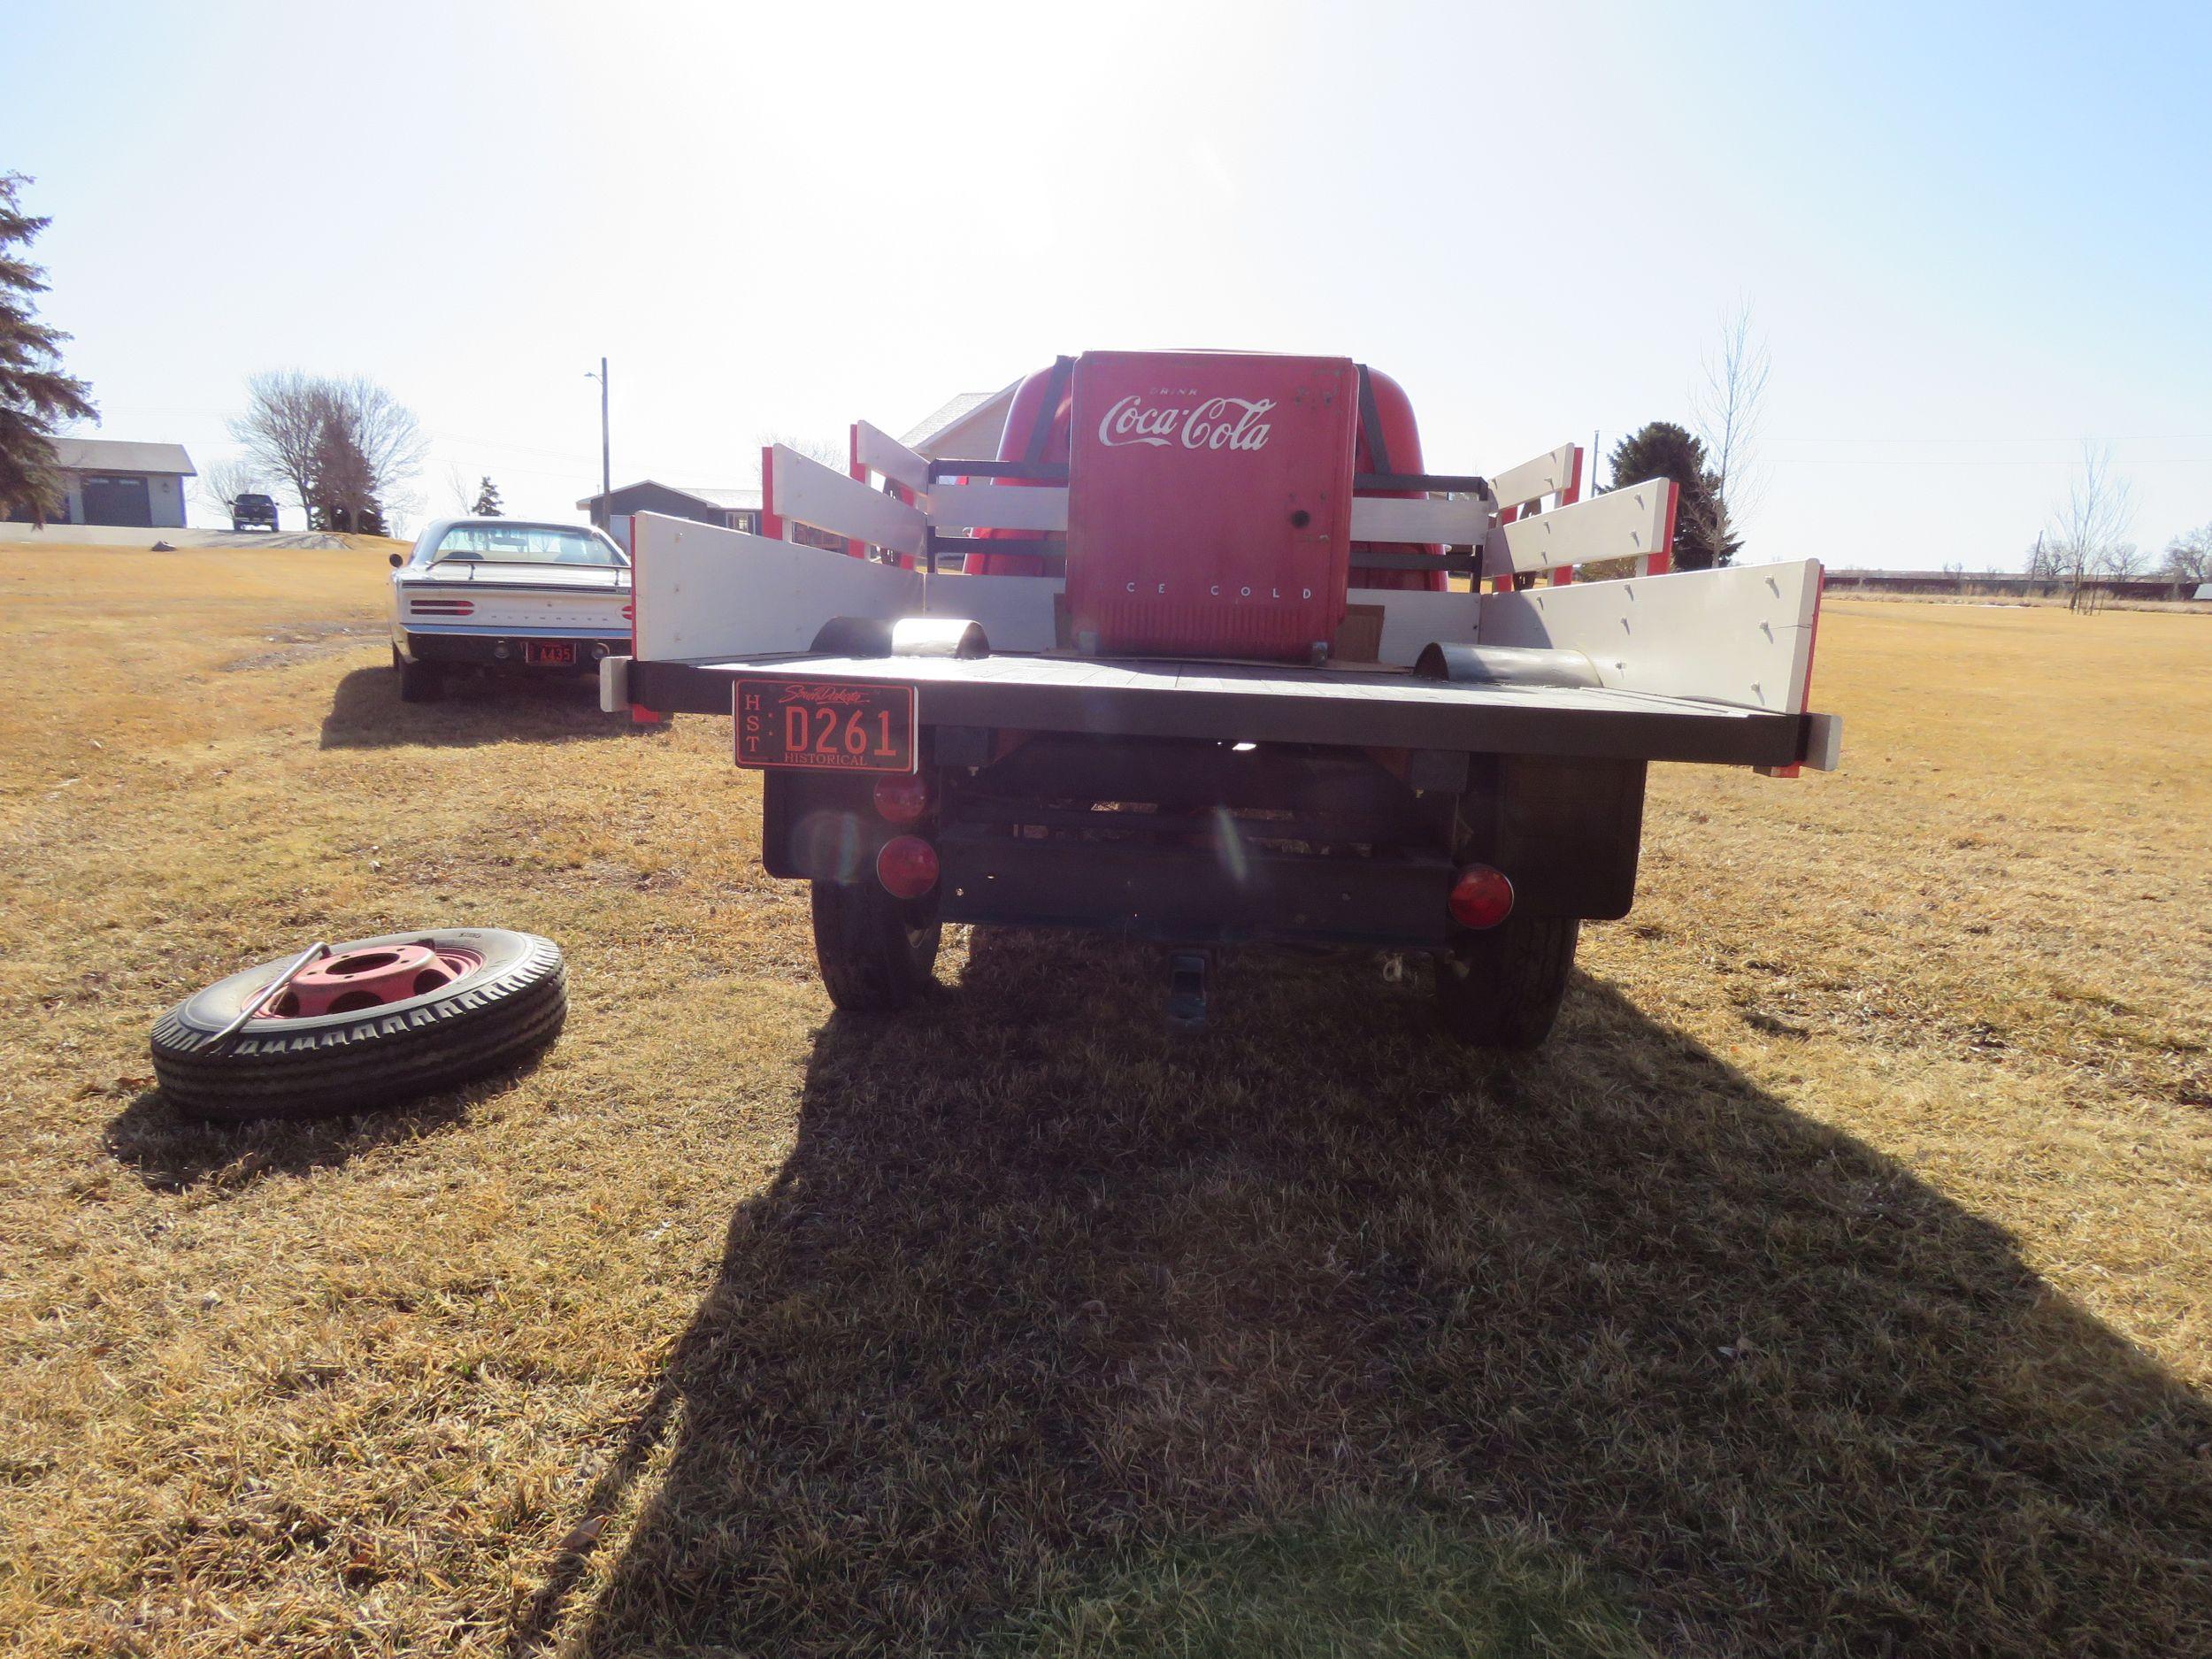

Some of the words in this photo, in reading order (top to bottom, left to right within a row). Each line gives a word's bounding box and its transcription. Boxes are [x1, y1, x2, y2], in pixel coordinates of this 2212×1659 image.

[1098, 395, 1277, 451] Coca-Cola
[1210, 585, 1312, 599] COLD
[779, 684, 821, 703] South
[816, 685, 870, 705] Dakota
[785, 706, 897, 757] D261
[784, 752, 868, 767] HISTORICAL
